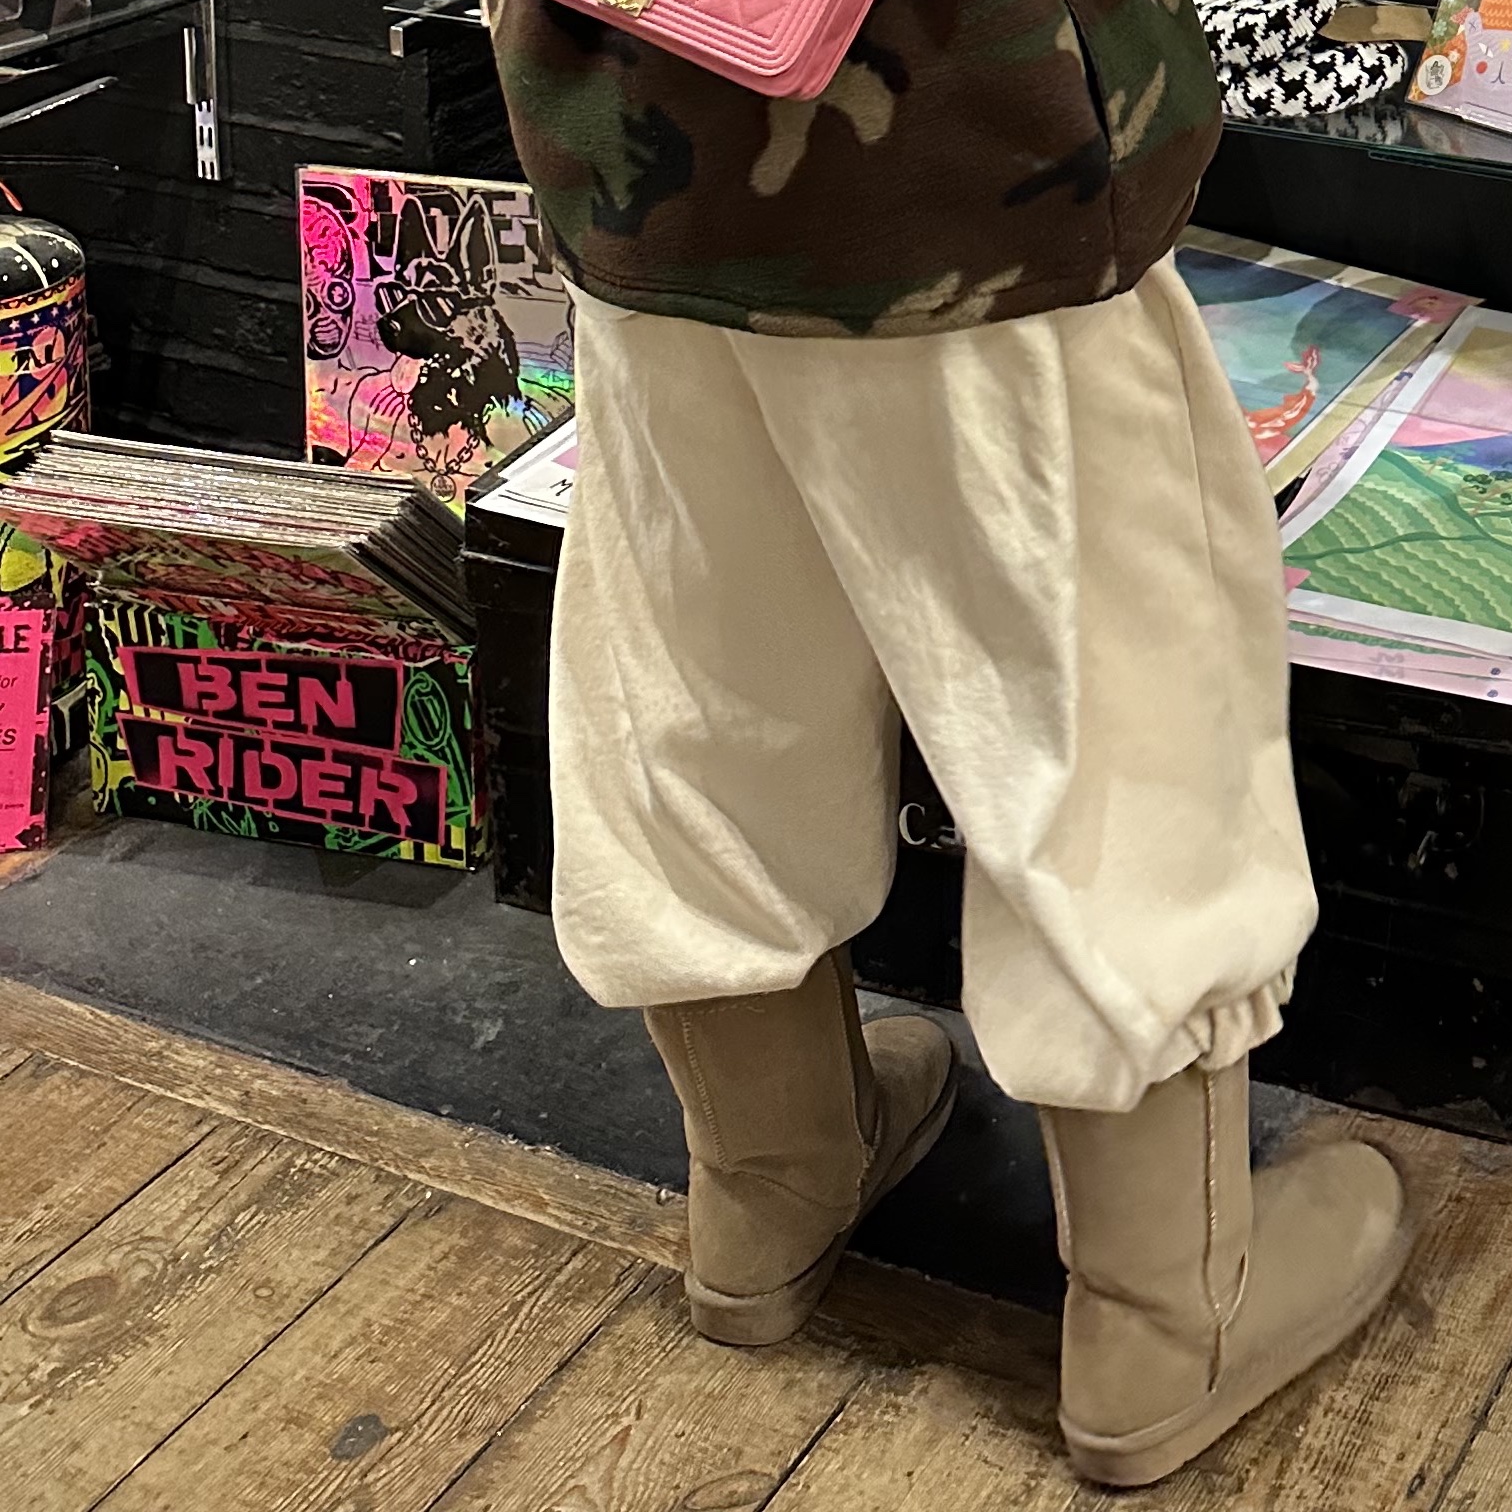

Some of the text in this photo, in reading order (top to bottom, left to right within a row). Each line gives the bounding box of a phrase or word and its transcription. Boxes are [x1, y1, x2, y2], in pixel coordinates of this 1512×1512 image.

[0, 674, 18, 689] or
[177, 662, 356, 729] BEN
[158, 734, 418, 829] RIDER
